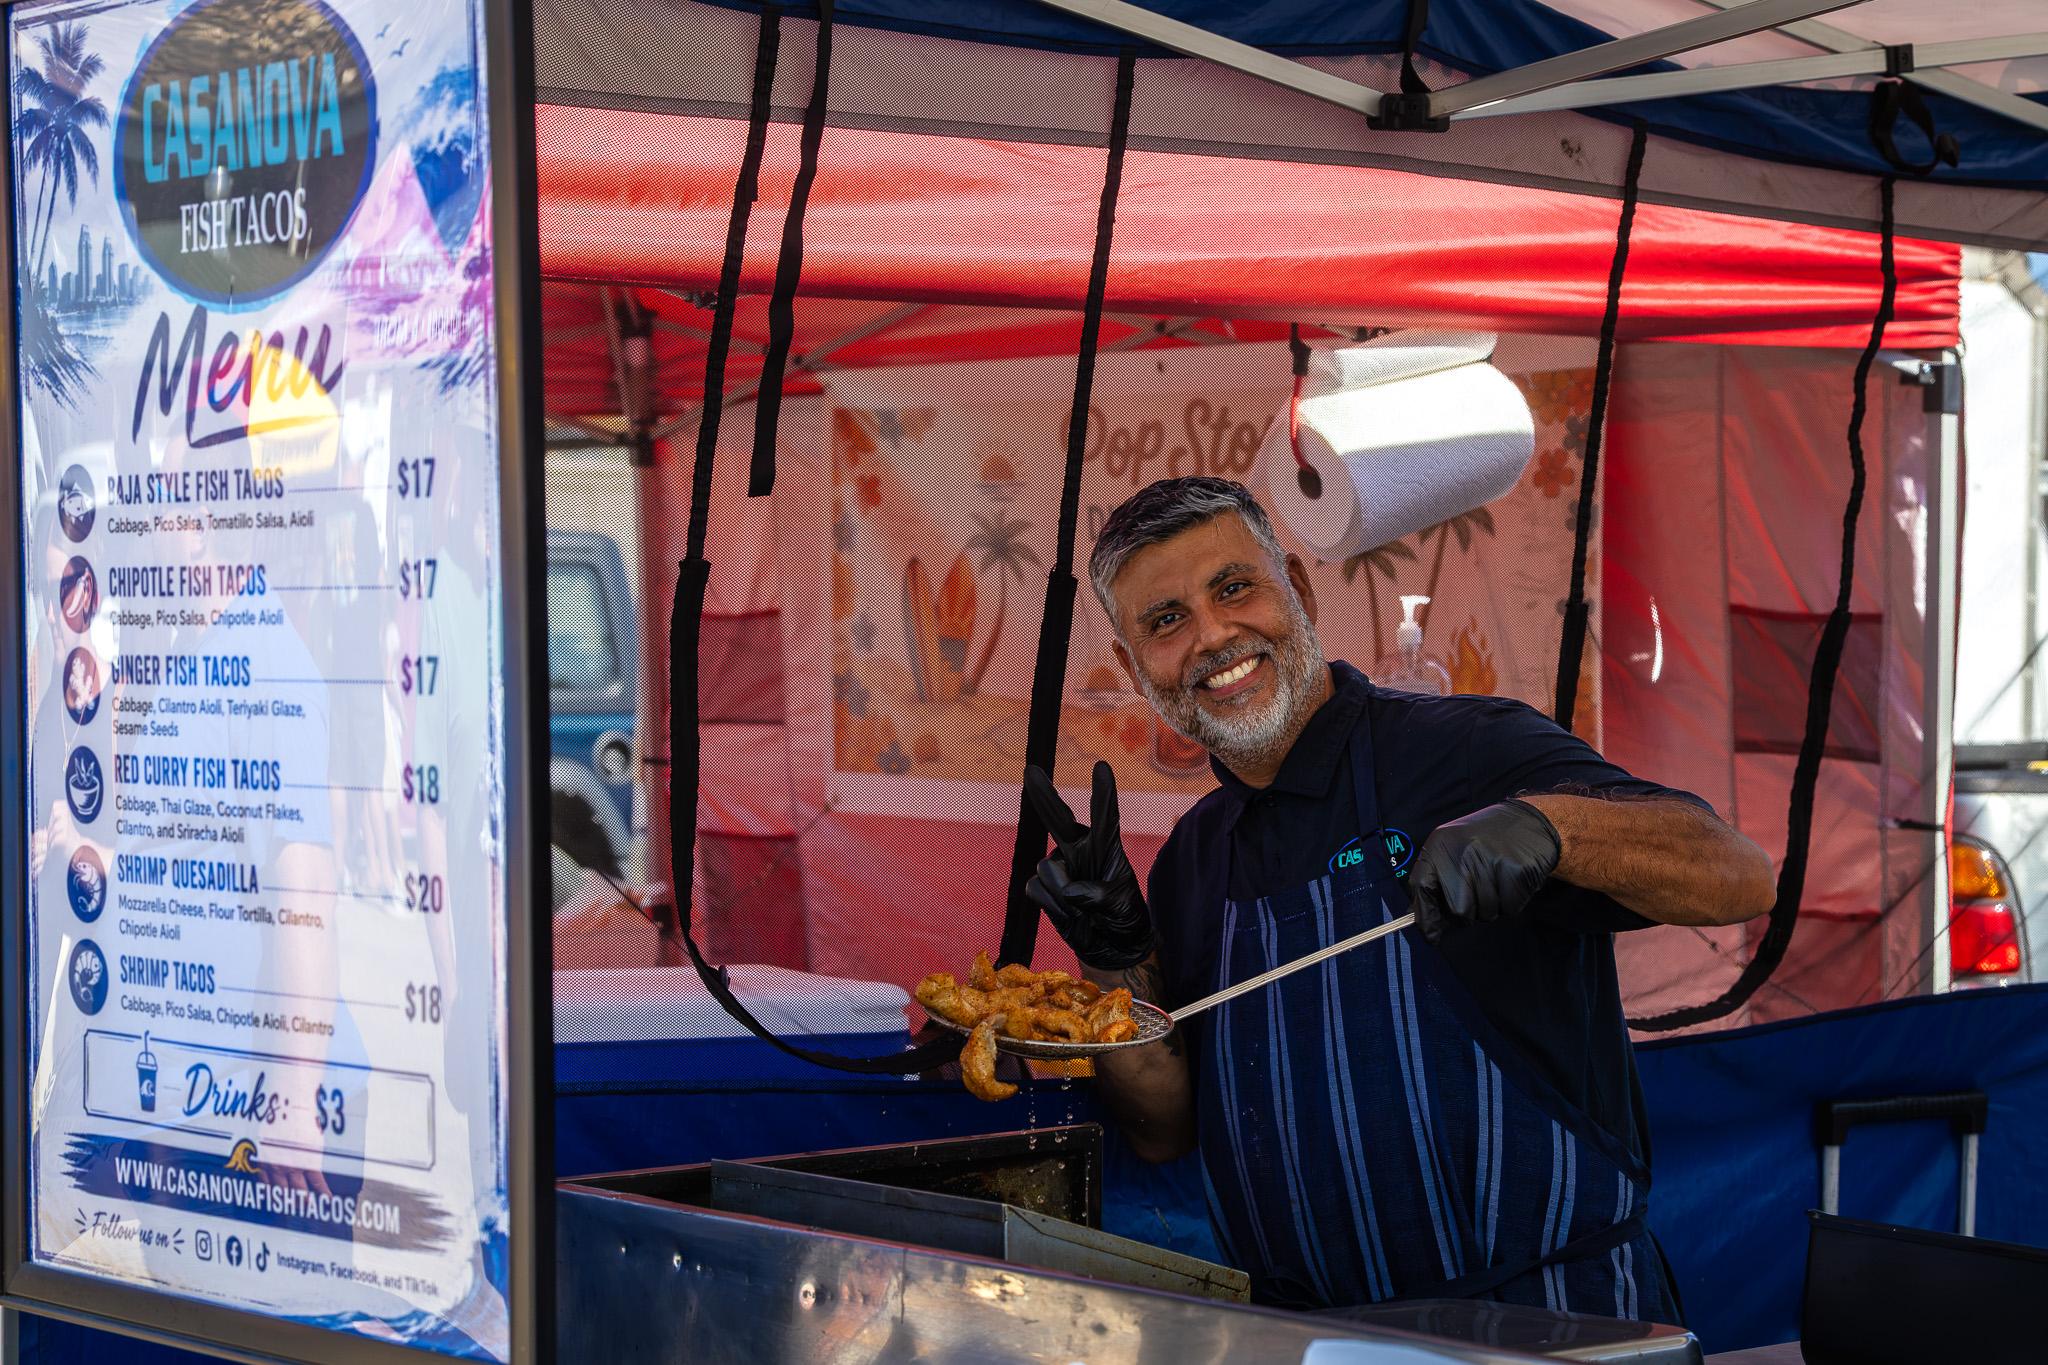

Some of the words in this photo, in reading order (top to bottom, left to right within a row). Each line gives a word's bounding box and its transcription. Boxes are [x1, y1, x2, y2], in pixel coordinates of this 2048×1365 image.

[142, 52, 345, 184] CASANOVA
[180, 197, 230, 254] FISH
[231, 187, 309, 248] TACOS
[132, 304, 350, 448] Menu
[1059, 403, 1164, 486] Pop
[1168, 397, 1276, 478] Sto
[108, 474, 142, 506] BAJA
[147, 471, 190, 503] STYLE
[196, 468, 229, 501] FISH
[234, 467, 284, 500] TACOS
[398, 457, 435, 500] $17
[108, 517, 152, 536] Cabbage,
[154, 515, 174, 532] Pico
[176, 514, 205, 533] Salsa,
[208, 512, 253, 530] Tomatillo
[256, 511, 287, 529] Salsa,
[290, 510, 314, 527] Aioli
[109, 566, 174, 598] CHIPOTLE
[180, 565, 212, 598] FISH
[217, 564, 266, 597] TACOS
[400, 558, 437, 601] $17
[156, 610, 177, 626] Pico
[179, 610, 208, 627] Salsa,
[211, 609, 255, 628] Chipotle
[258, 608, 284, 625] Aioli
[111, 654, 161, 687] GINGER
[166, 655, 197, 687] FISH
[203, 656, 250, 688] TACOS
[402, 654, 438, 696] $17
[112, 697, 156, 718] Cabbage,
[158, 698, 197, 715] Cilantro
[199, 698, 225, 717] Aioli,
[228, 699, 269, 719] Teriyaki
[272, 700, 306, 719] Glaze,
[113, 720, 148, 736] Sesame
[150, 721, 179, 737] Seeds
[114, 754, 139, 784] RED
[144, 755, 188, 787] CURRY
[194, 757, 226, 790] FISH
[231, 759, 281, 792] TACOS
[404, 761, 440, 804] $18
[116, 795, 158, 815] Cabbage,
[160, 797, 181, 814] Thai
[184, 798, 215, 818] Glaze,
[216, 801, 262, 820] Coconut
[266, 803, 304, 823] Flakes,
[116, 820, 154, 839] Cilantro,
[156, 824, 174, 839] and
[177, 825, 218, 842] Sriracha
[220, 827, 245, 844] Aioli
[118, 854, 167, 887] SHRIMP
[172, 858, 259, 894] QUESADILLA
[405, 872, 443, 914] $20
[118, 895, 167, 914] Mozzarella
[169, 898, 206, 920] Cheese,
[209, 902, 235, 920] Flour
[238, 904, 276, 926] Tortilla,
[278, 910, 324, 930] Cilantro,
[119, 918, 158, 939] Chipotle
[160, 923, 180, 940] Aioli
[120, 954, 169, 990] SHRIMP
[174, 960, 215, 995] TACOS
[405, 981, 441, 1025] $18
[121, 995, 164, 1018] Cabbage,
[166, 1000, 184, 1018] Pico
[187, 1003, 215, 1024] Salsa,
[216, 1008, 259, 1030] Chipotle
[262, 1013, 290, 1033] Aioli,
[292, 1016, 334, 1037] Cilantro
[182, 1062, 289, 1125] Drinks:
[315, 1083, 346, 1136] $3
[115, 1157, 401, 1235] WWW.CASANOVAFISHTACOS.COM
[92, 1211, 139, 1243] Follow
[140, 1230, 153, 1247] us
[154, 1233, 170, 1249] on
[277, 1252, 329, 1278] Instagram,
[331, 1262, 379, 1287] Facebook,
[382, 1271, 402, 1291] and
[404, 1275, 439, 1297] TikTok
